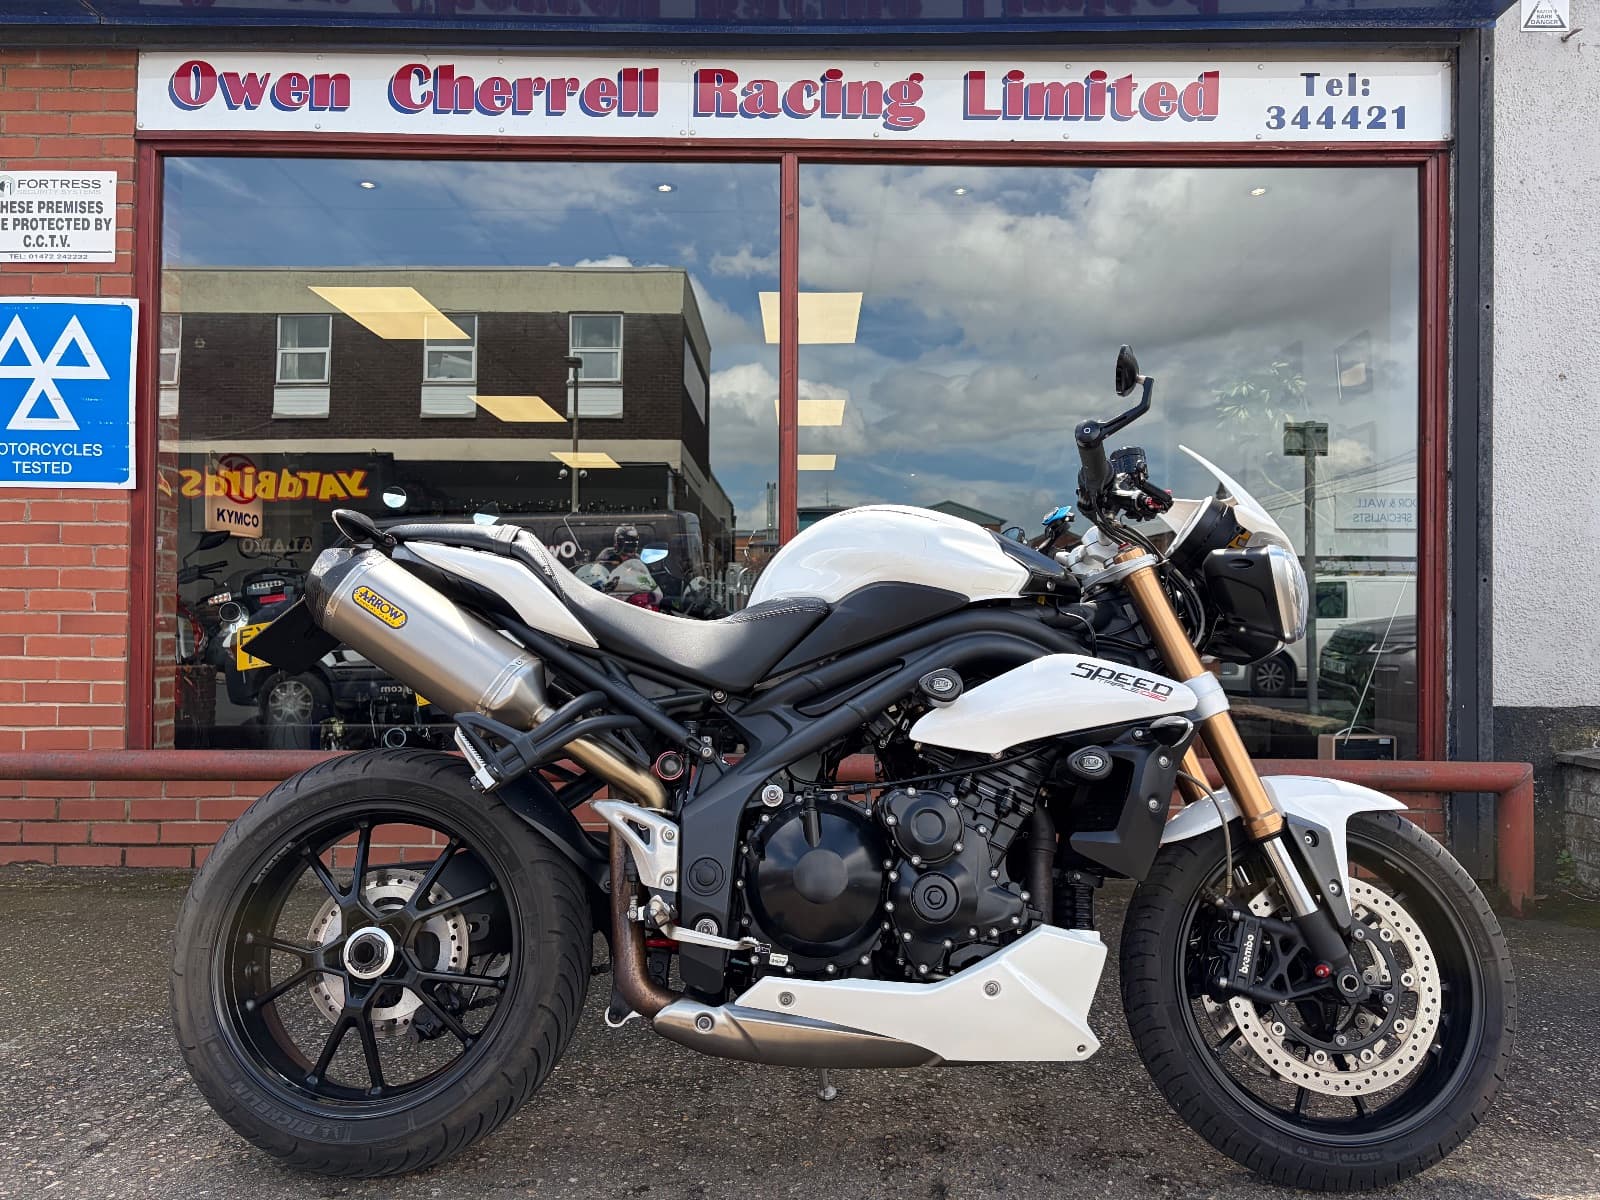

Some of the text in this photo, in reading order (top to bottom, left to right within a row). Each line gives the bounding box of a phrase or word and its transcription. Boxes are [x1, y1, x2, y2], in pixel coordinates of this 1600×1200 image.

[1300, 72, 1371, 98] Tel:
[168, 60, 1220, 132] Owen Cherrell Racing Limited
[1265, 105, 1408, 131] 344421
[17, 179, 102, 189] FORTRESS
[0, 201, 104, 214] HESE PREMISES
[12, 217, 91, 231] PROTECTED
[94, 217, 113, 231] BY
[23, 234, 71, 248] C.C.T.V.
[0, 442, 103, 456] OTORCYCLES
[12, 461, 73, 475] TESTED
[216, 508, 259, 528] KYMCO
[359, 590, 403, 620] ARROW
[1070, 662, 1174, 697] SPEED
[1239, 934, 1255, 974] brembo
